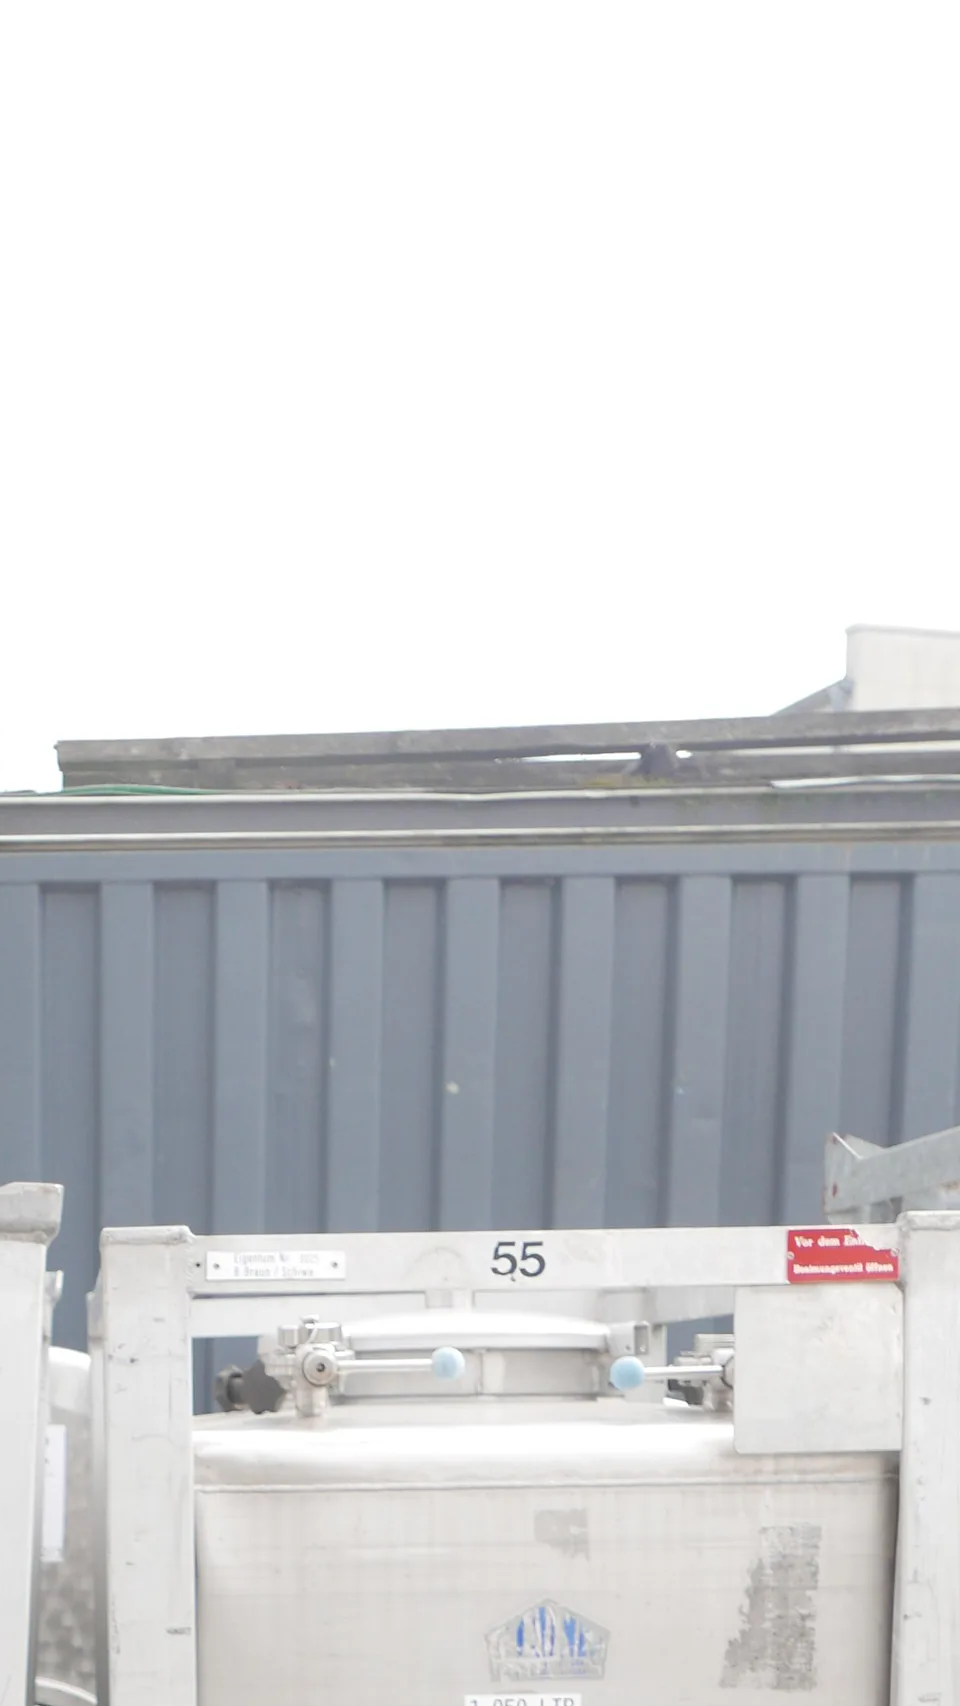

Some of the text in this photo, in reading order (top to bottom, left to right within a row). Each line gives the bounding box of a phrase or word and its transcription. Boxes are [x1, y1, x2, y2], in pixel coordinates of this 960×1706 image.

[794, 1236, 814, 1248] Vor
[817, 1235, 841, 1247] dem
[491, 1241, 546, 1278] 55
